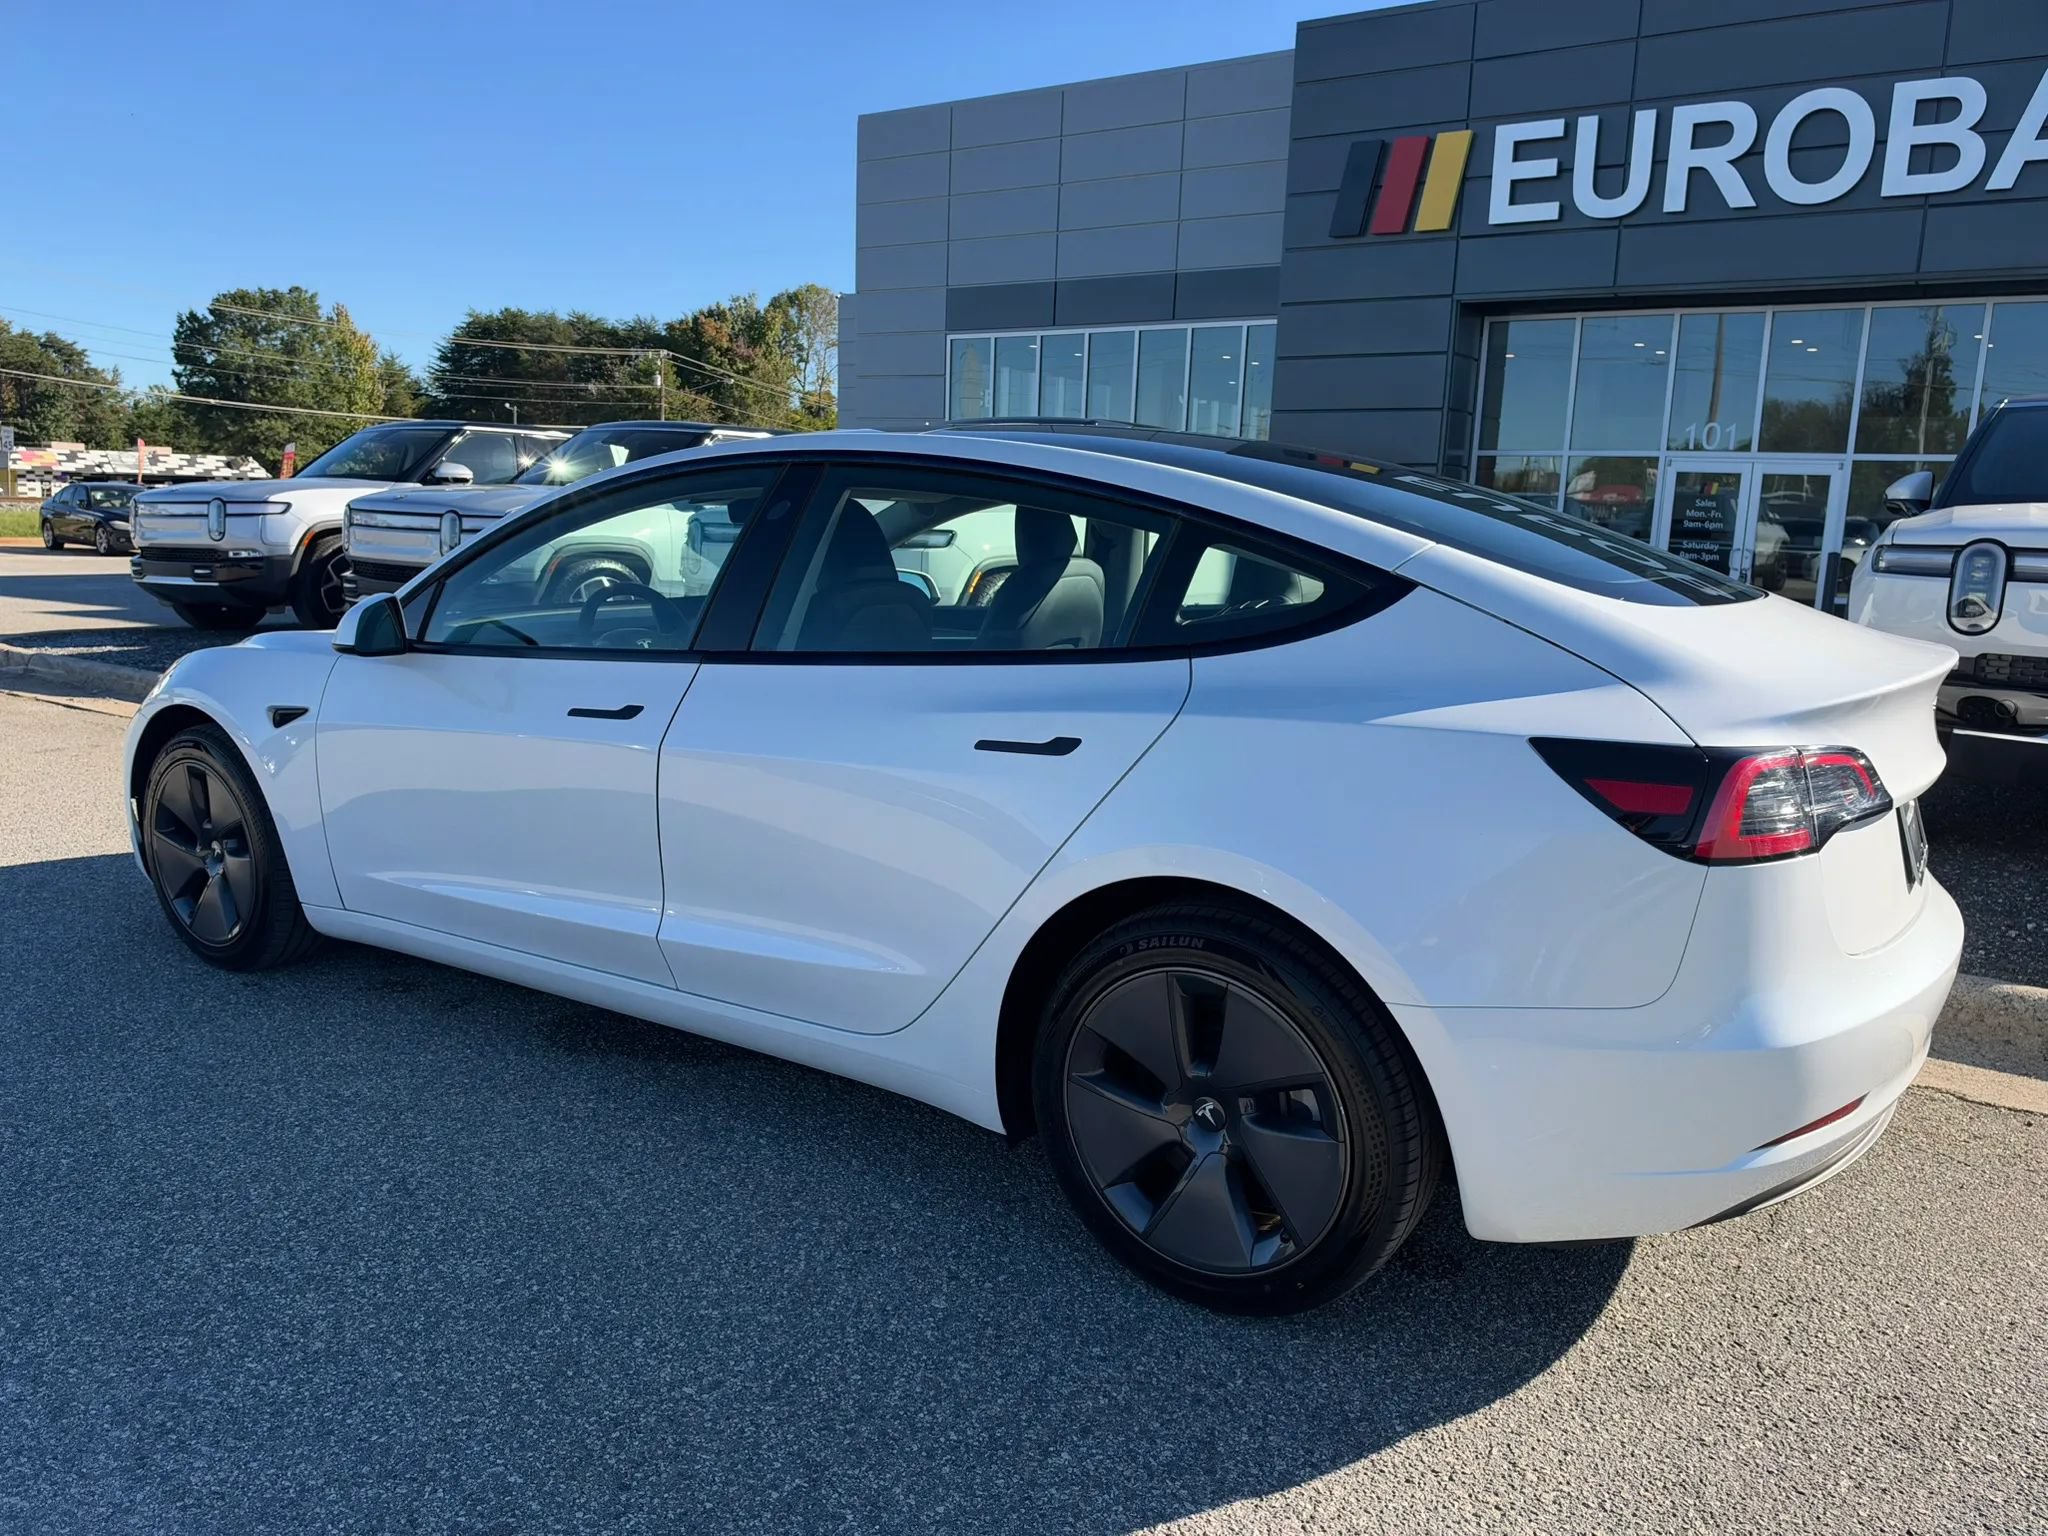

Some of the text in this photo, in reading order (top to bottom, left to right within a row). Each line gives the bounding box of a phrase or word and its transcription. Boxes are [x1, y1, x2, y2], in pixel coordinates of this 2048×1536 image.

[1685, 422, 1738, 450] 101
[1695, 498, 1717, 508] Sales
[1683, 520, 1724, 530] 9am-6pm
[1682, 541, 1719, 552] Saturday
[1138, 936, 1205, 950] SAILUN
